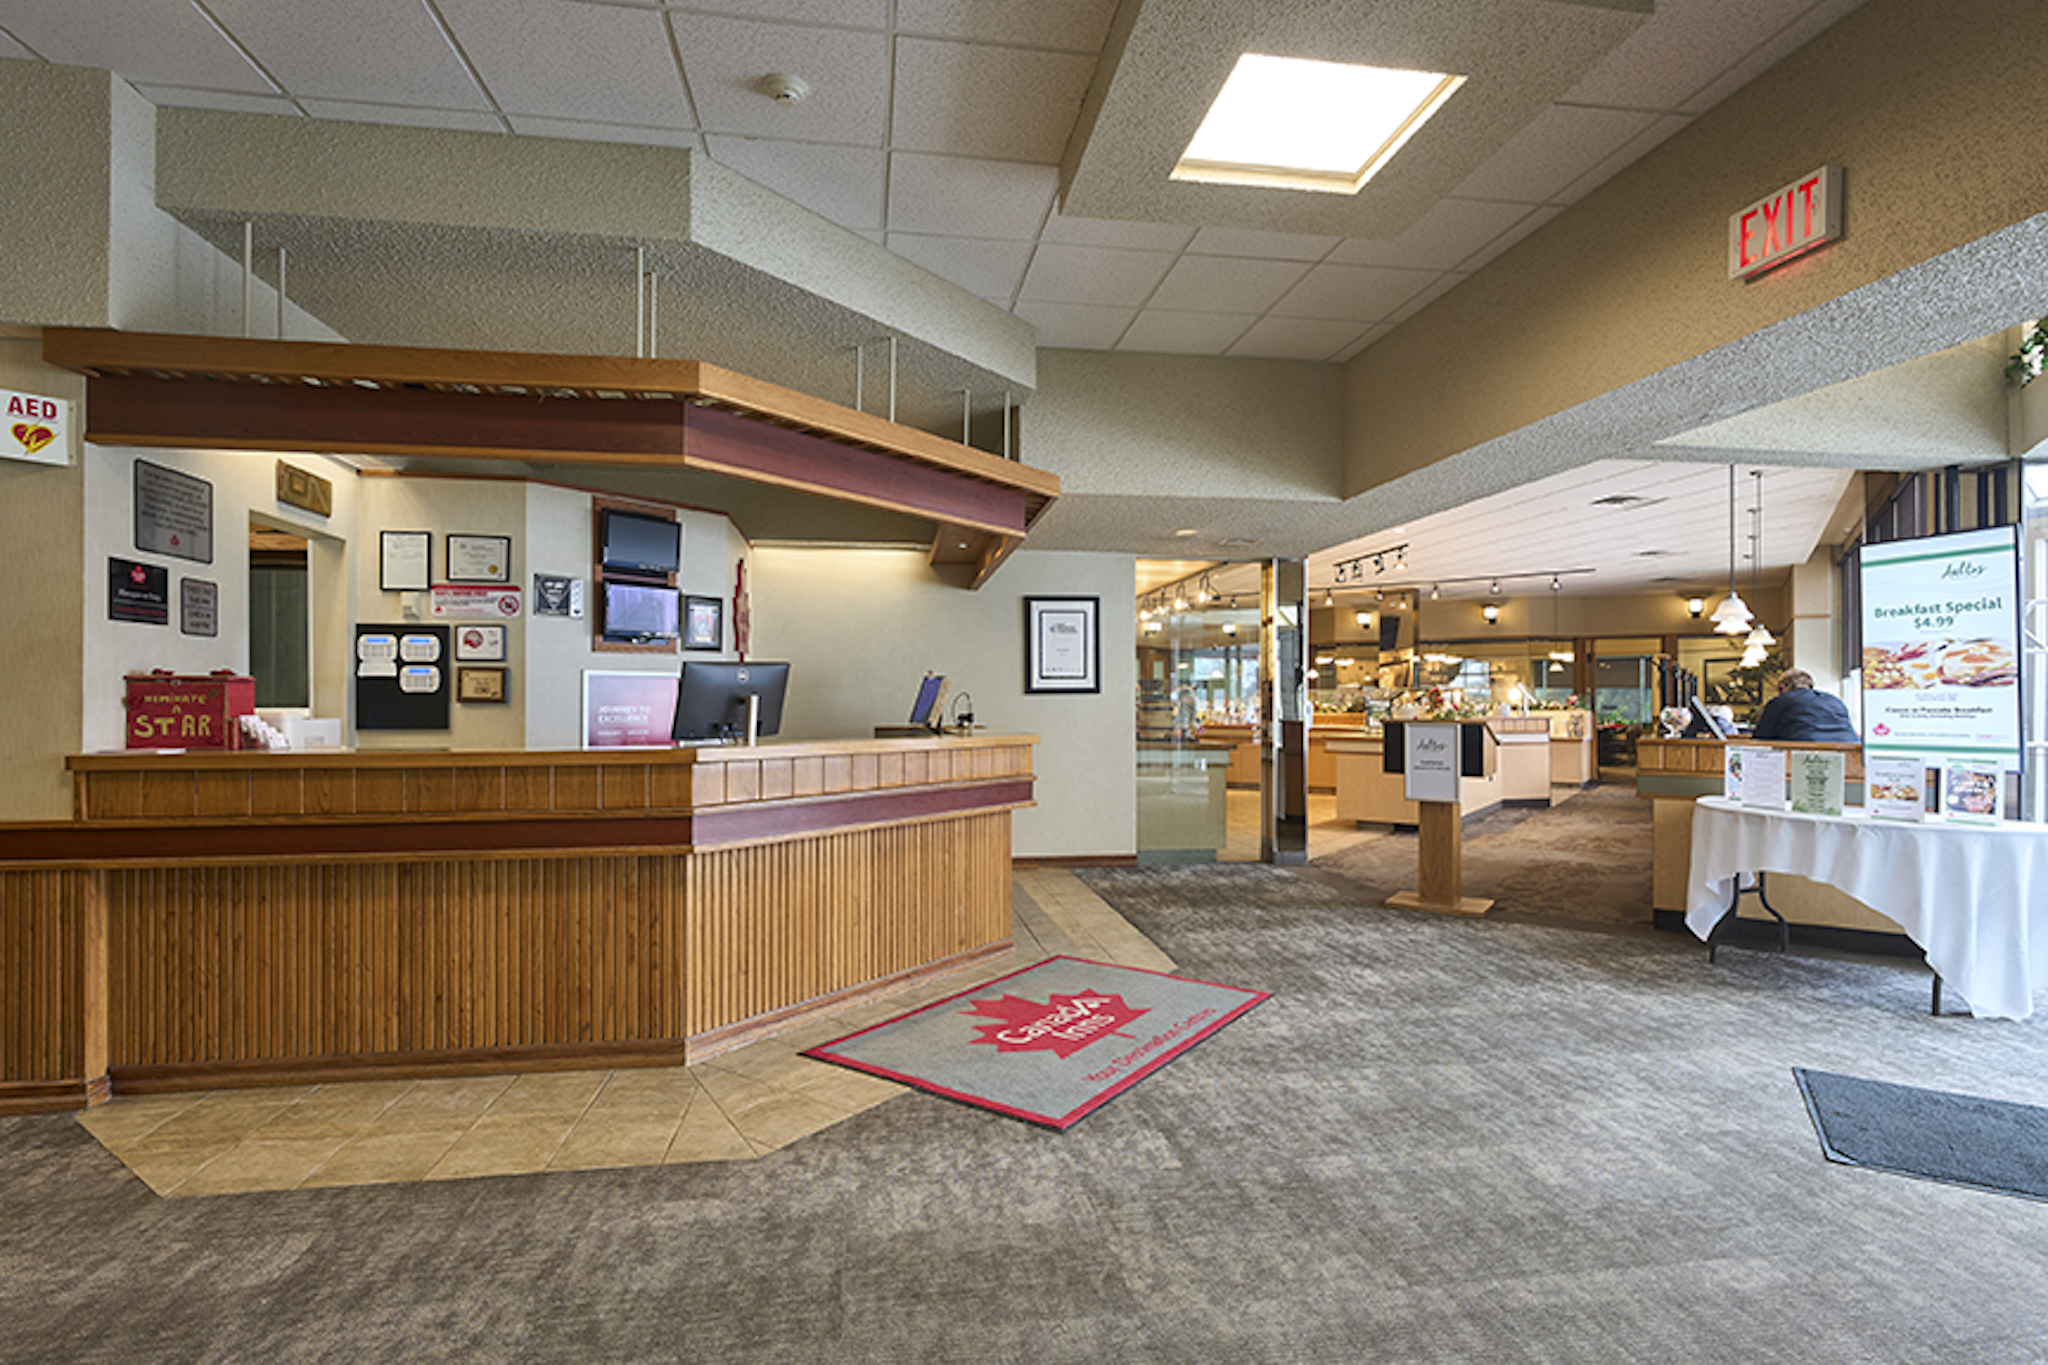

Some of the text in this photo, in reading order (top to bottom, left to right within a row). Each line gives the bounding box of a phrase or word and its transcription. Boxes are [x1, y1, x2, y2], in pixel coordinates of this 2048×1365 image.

[1740, 177, 1818, 267] EXIT
[8, 396, 57, 419] AED
[1874, 597, 2002, 618] Breakfast Special
[1914, 616, 1954, 629] $4.99
[172, 704, 181, 714] A
[134, 714, 211, 737] STAR
